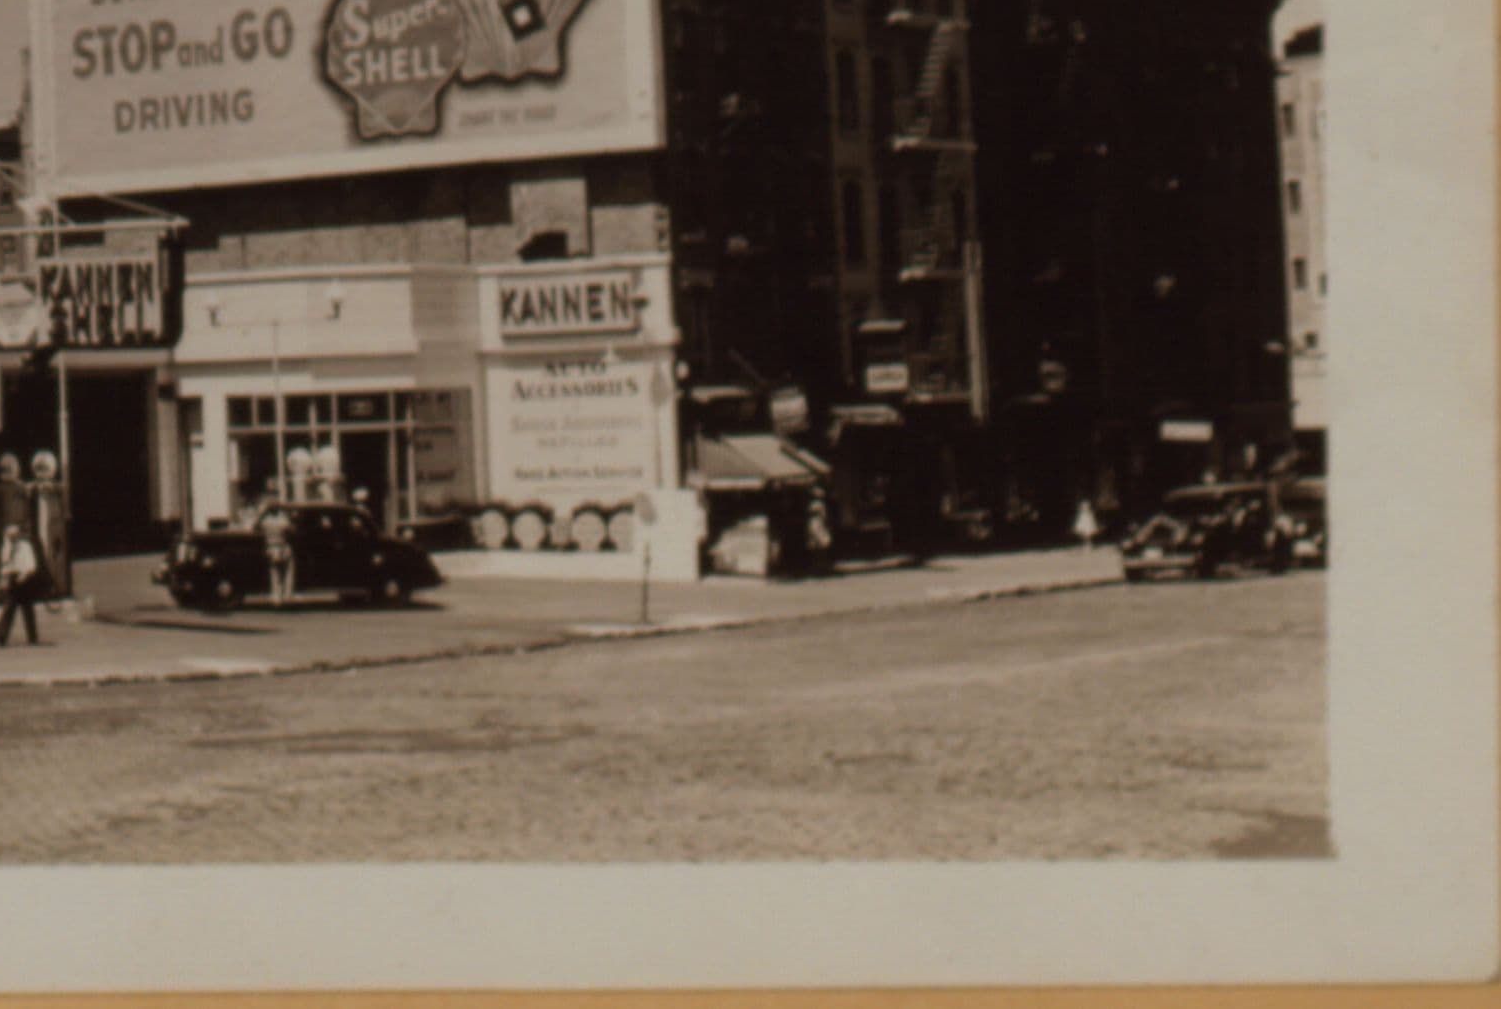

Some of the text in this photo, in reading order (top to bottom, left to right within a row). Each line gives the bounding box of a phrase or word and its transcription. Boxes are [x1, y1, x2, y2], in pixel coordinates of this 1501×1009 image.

[72, 5, 294, 80] STOP and GO
[342, 45, 447, 86] SHELL
[114, 87, 256, 134] DRIVING
[40, 263, 154, 305] KANNEN
[500, 280, 631, 326] KANNEN
[49, 302, 158, 345] SHELL
[544, 356, 607, 377] AUTO
[511, 376, 640, 401] ACCESSORIES
